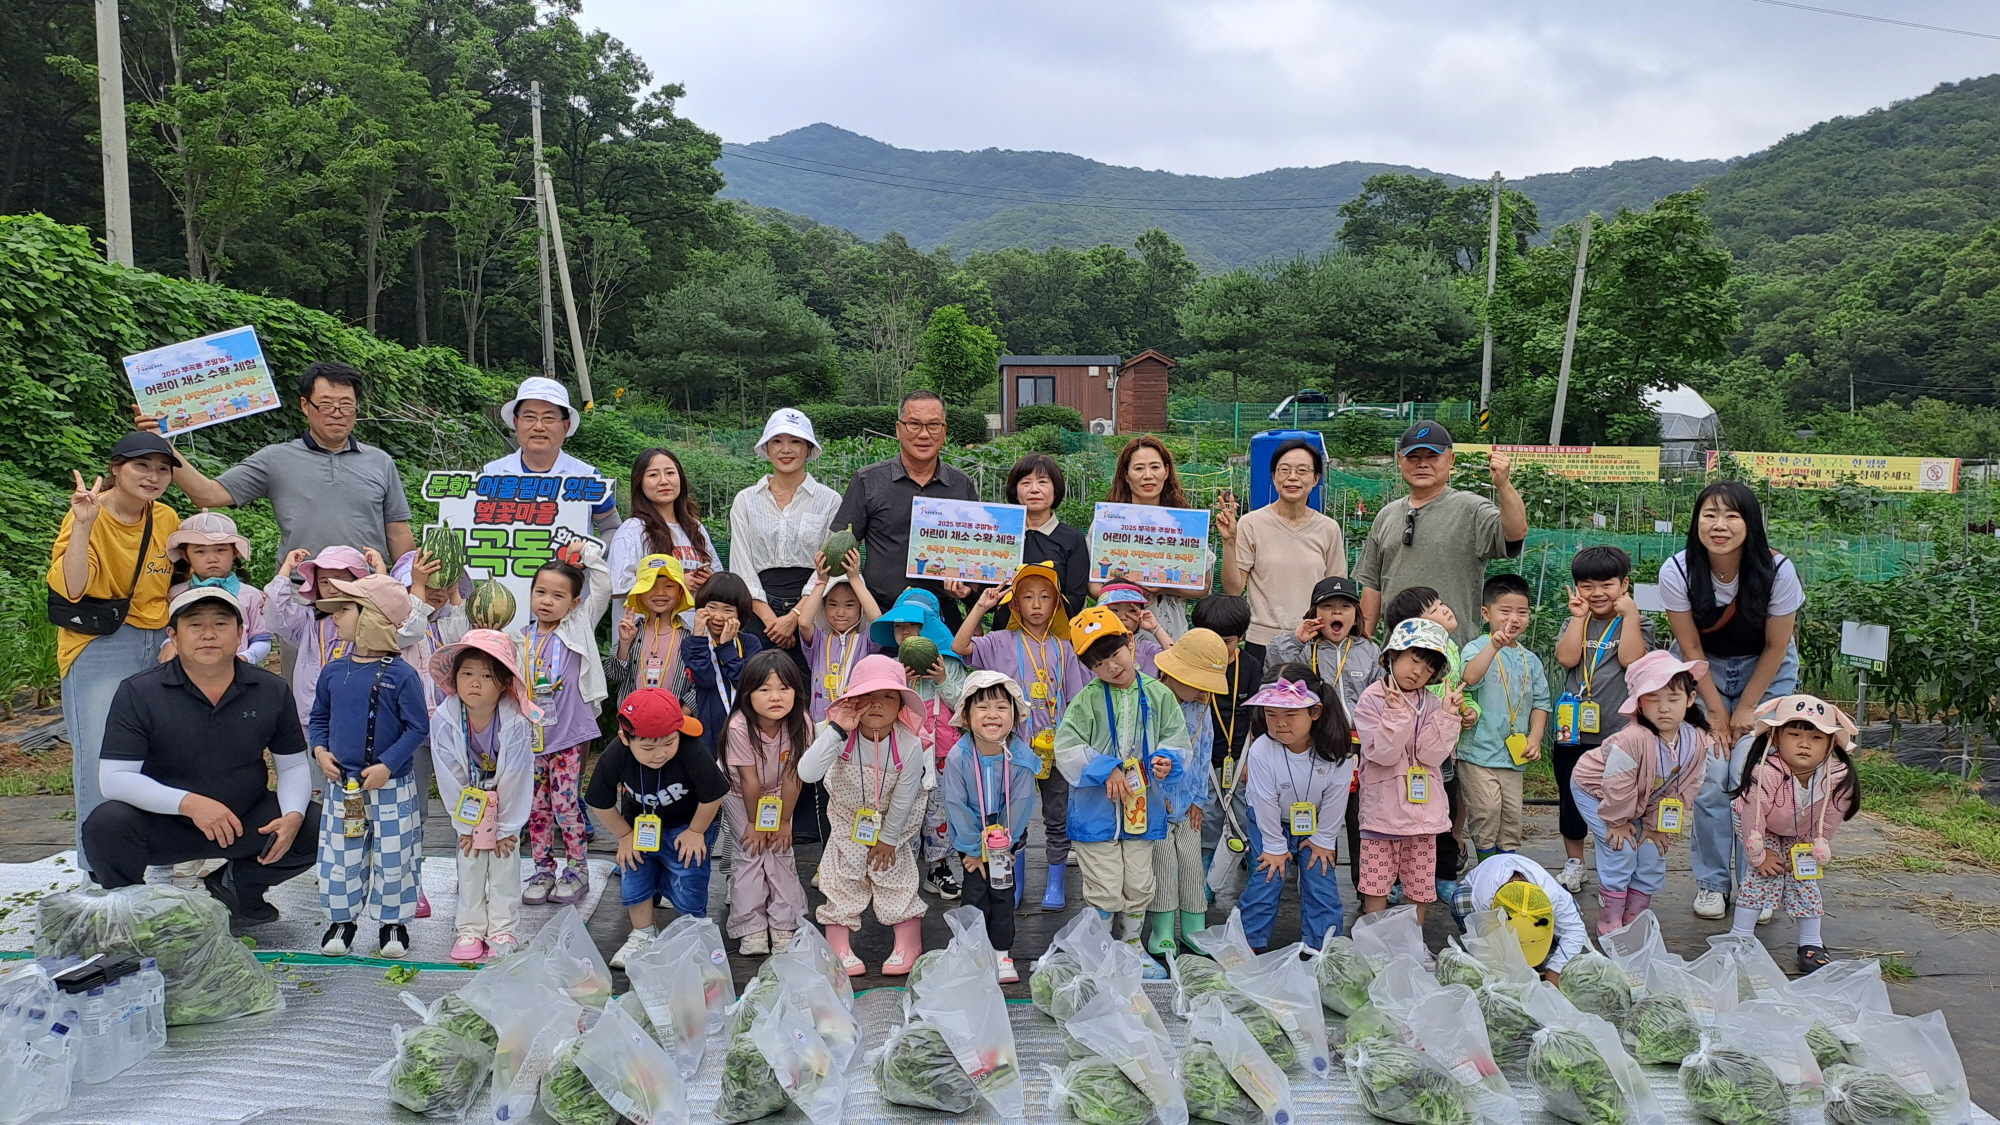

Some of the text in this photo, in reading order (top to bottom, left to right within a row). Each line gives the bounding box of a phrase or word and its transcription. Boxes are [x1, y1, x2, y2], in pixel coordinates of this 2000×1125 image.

[161, 355, 233, 379] 2025 부곡동 주말농장
[145, 358, 257, 396] 어린이 채소 수확 체험
[1779, 456, 1788, 466] 한
[1793, 457, 1815, 467] 순간,
[1852, 458, 1862, 468] 한
[1866, 459, 1886, 469] 평생
[562, 477, 606, 500] 있는
[475, 501, 559, 525] 벚꽃마을
[955, 522, 973, 530] 부곡동
[974, 523, 999, 532] 주말농장
[1120, 524, 1183, 535] 2025 부곡동 주말농장
[920, 528, 1016, 545] 어린이 채소 수확 체험
[1102, 532, 1200, 549] 어린이 채소 수확 체험
